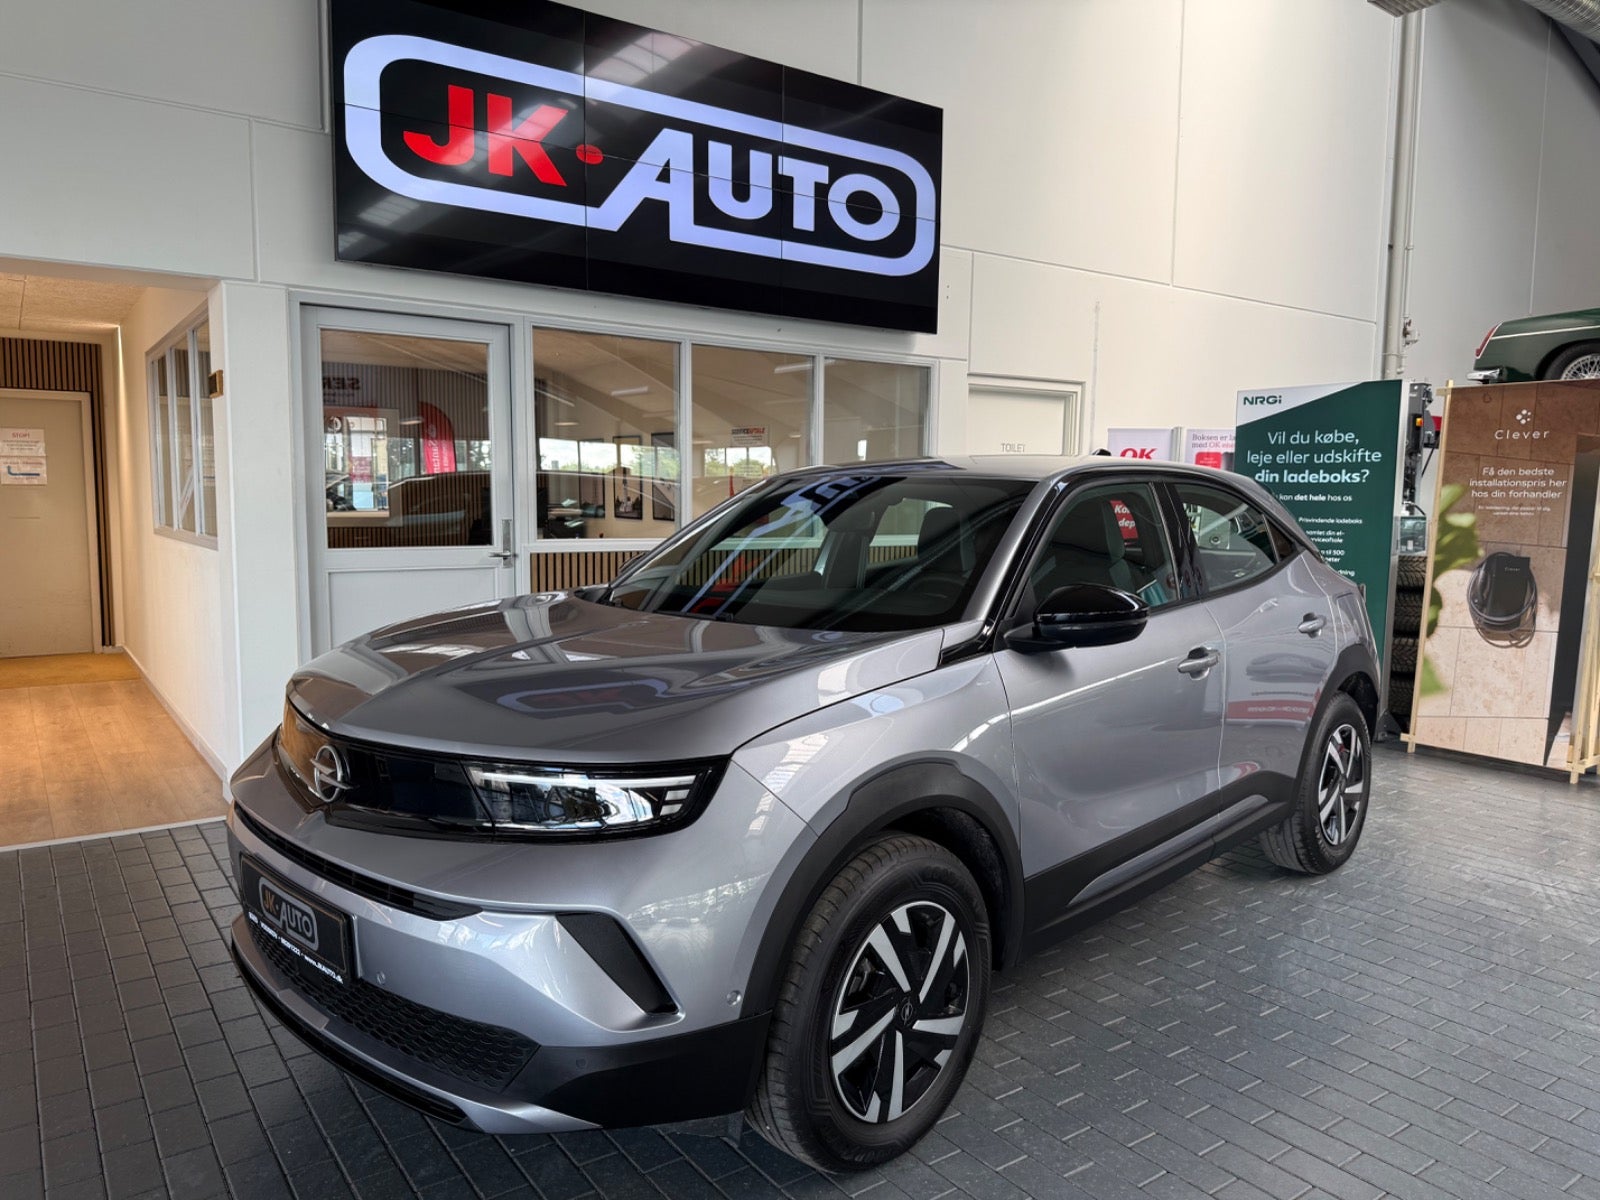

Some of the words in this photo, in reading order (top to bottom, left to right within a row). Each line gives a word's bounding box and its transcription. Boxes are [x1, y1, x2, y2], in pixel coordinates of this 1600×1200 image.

[597, 128, 900, 241] AUTO
[1243, 395, 1283, 406] NRGi
[1192, 433, 1219, 442] Boksen
[1267, 431, 1286, 445] Vil
[1289, 430, 1310, 445] du
[1314, 429, 1360, 445] købe,
[1494, 429, 1550, 440] Clever
[1000, 442, 1025, 453] TOILET
[1208, 441, 1221, 449] OK
[1246, 450, 1273, 467] leje
[1276, 450, 1310, 464] eller
[1313, 447, 1382, 464] udskifte
[1254, 469, 1279, 483] din
[1283, 468, 1370, 483] ladeboks?
[1482, 466, 1495, 476] Få
[1497, 467, 1516, 476] den
[1518, 467, 1555, 476] bedste
[1469, 478, 1546, 489] installationspris
[1549, 478, 1568, 487] her
[1471, 489, 1489, 498] hos
[1491, 490, 1506, 498] din
[1508, 489, 1563, 499] forhandler
[280, 901, 314, 938] AUTO
